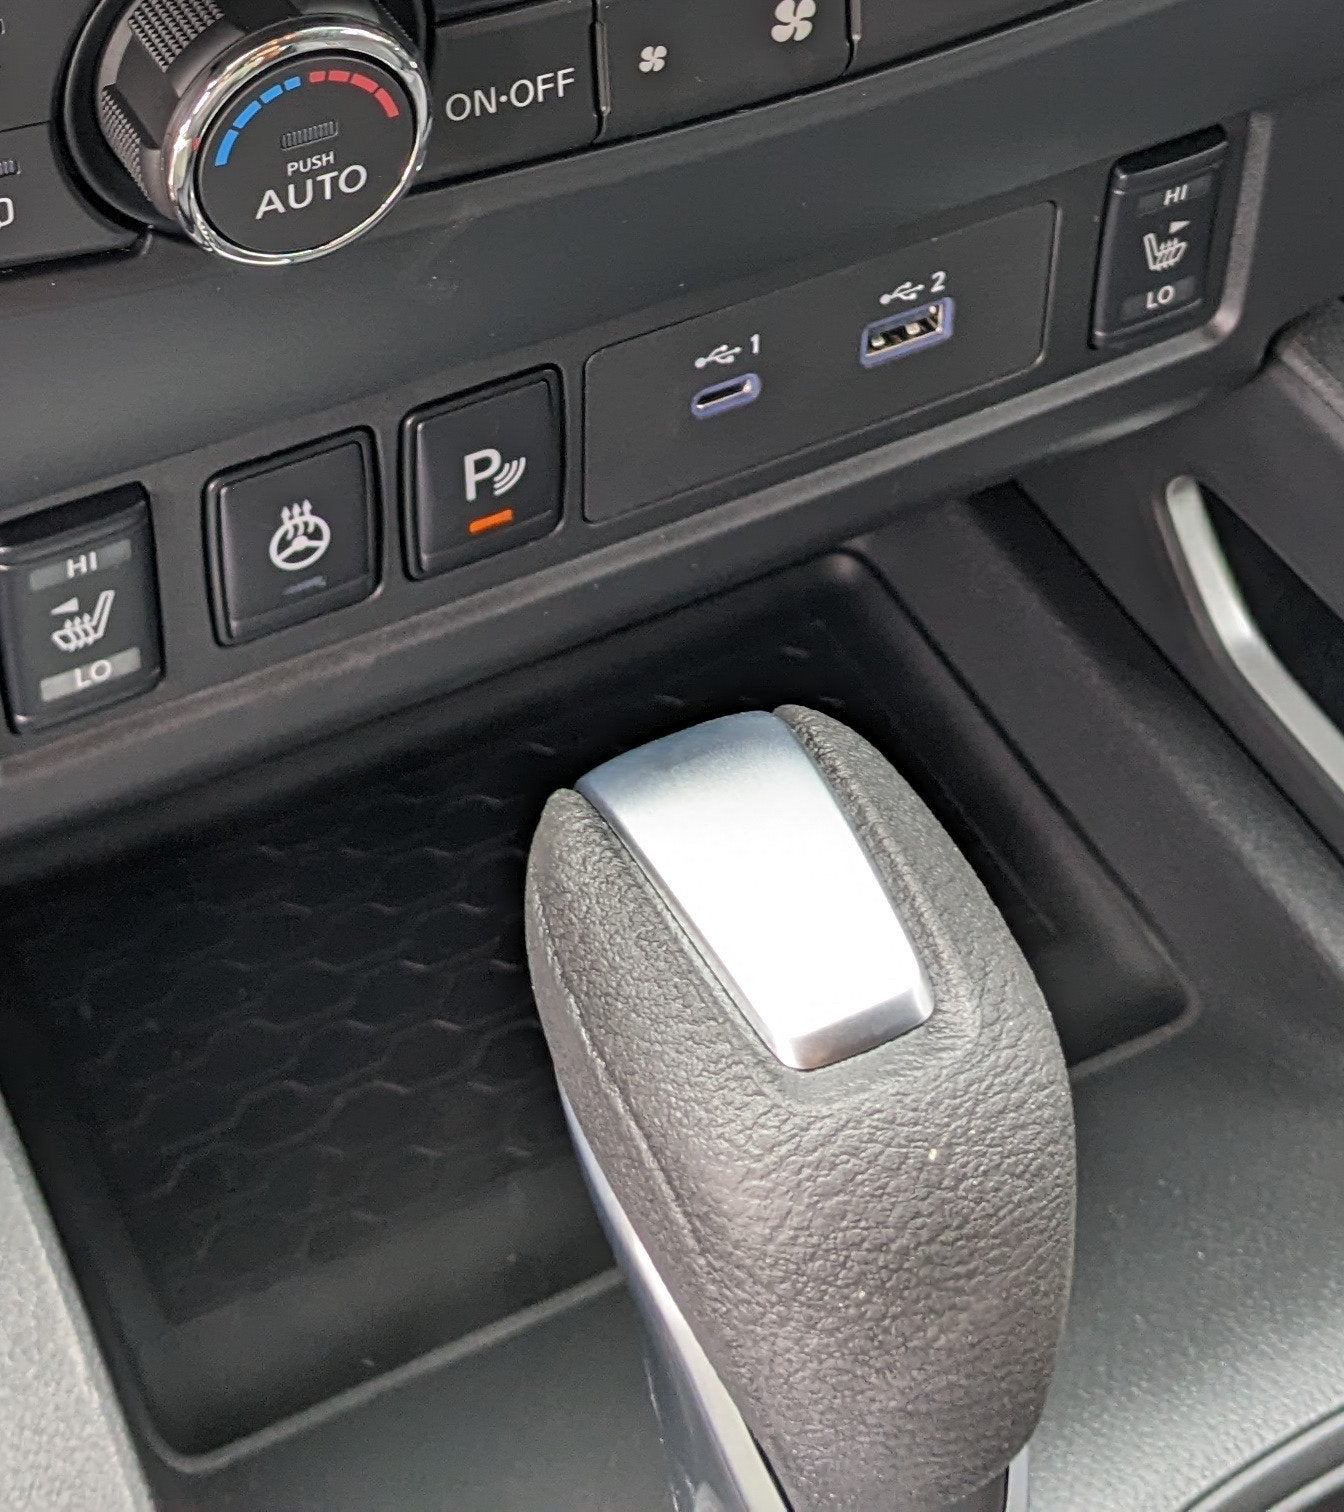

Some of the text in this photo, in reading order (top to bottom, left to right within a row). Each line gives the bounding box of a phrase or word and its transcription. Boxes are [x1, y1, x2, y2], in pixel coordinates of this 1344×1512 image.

[286, 150, 336, 178] PUSH
[255, 164, 369, 221] AUTO
[1162, 182, 1189, 206] HI
[1144, 284, 1176, 311] LO
[64, 550, 99, 579] HI
[73, 658, 114, 690] LO
